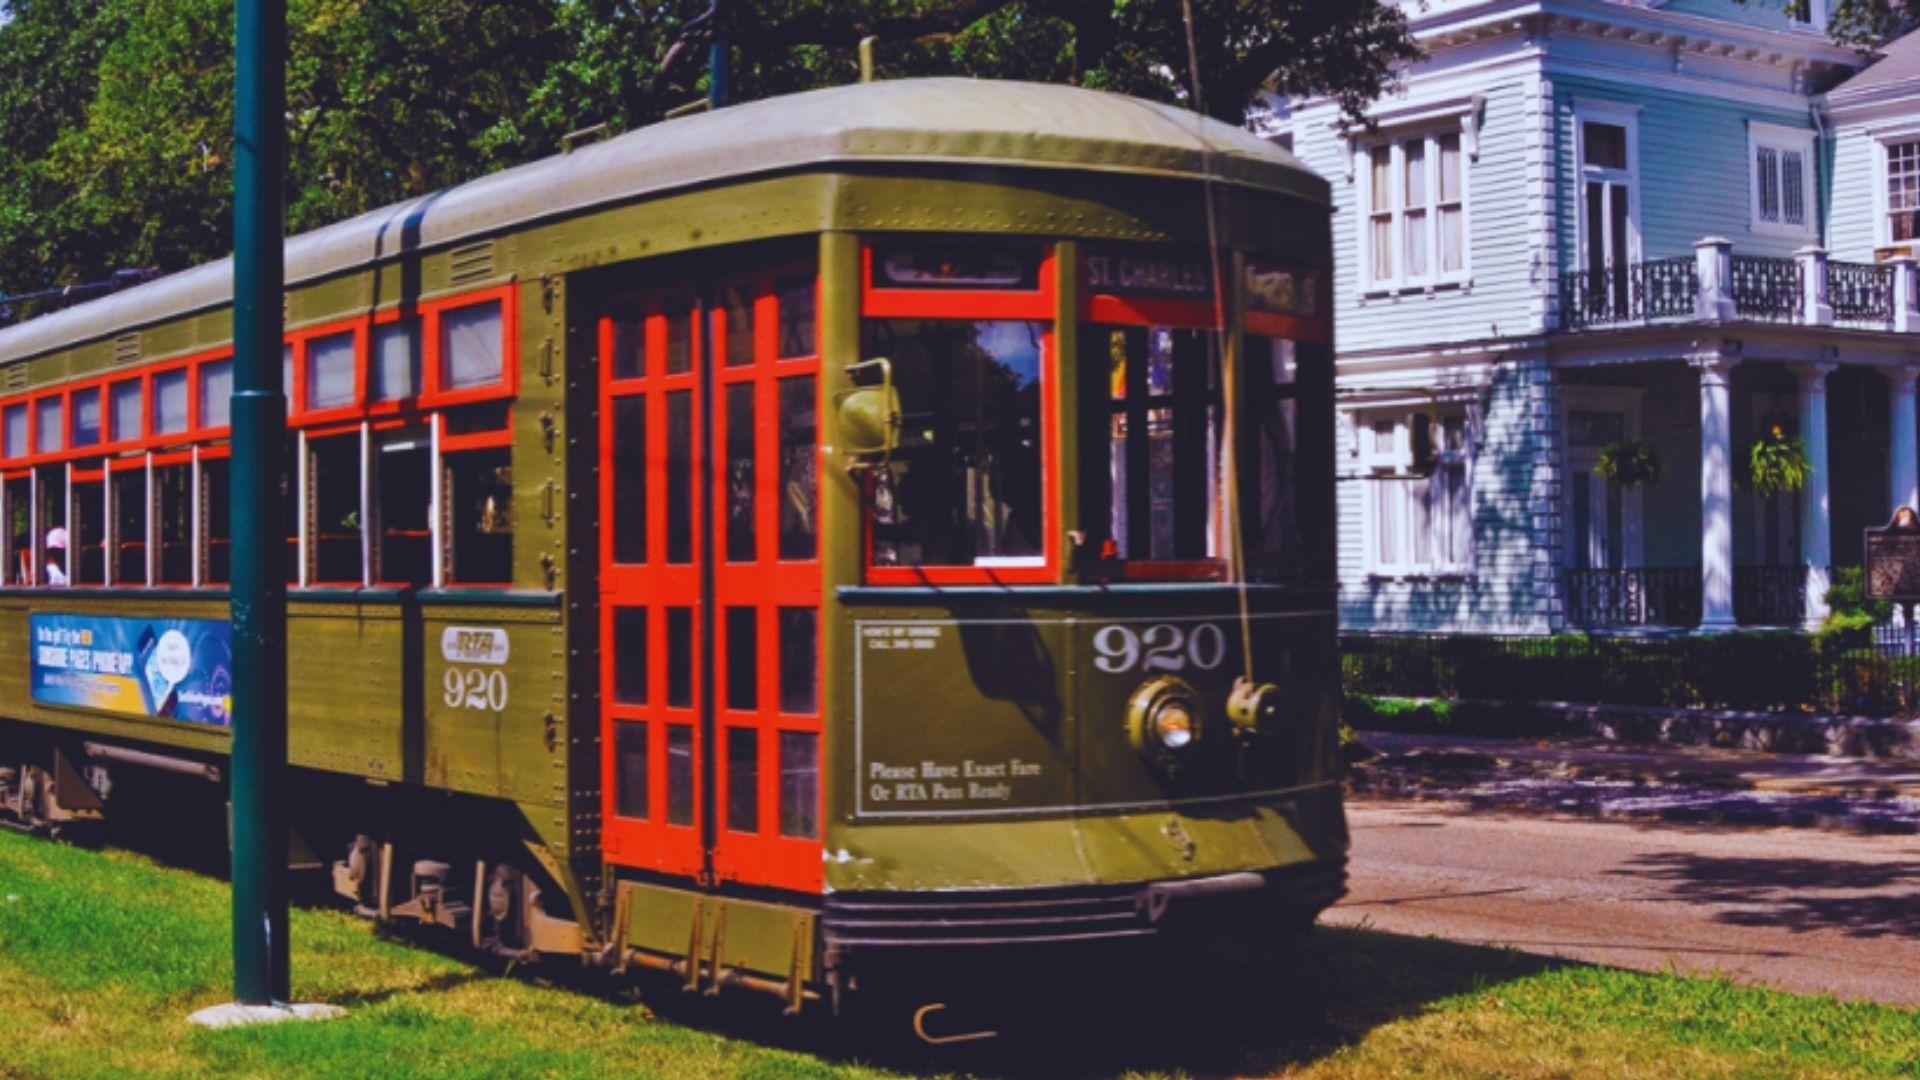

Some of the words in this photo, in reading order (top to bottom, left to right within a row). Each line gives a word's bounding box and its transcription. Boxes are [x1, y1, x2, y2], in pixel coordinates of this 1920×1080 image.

[1118, 259, 1207, 291] CHARLES
[1093, 623, 1226, 673] 920
[443, 667, 508, 712] 920
[869, 761, 917, 779] Please
[922, 760, 959, 778] Have
[963, 759, 1006, 778] Exact
[1010, 758, 1042, 776] Fare
[870, 783, 891, 801] Or
[895, 782, 928, 800] RTA
[932, 782, 964, 800] Pass
[968, 781, 1011, 801] Ready
